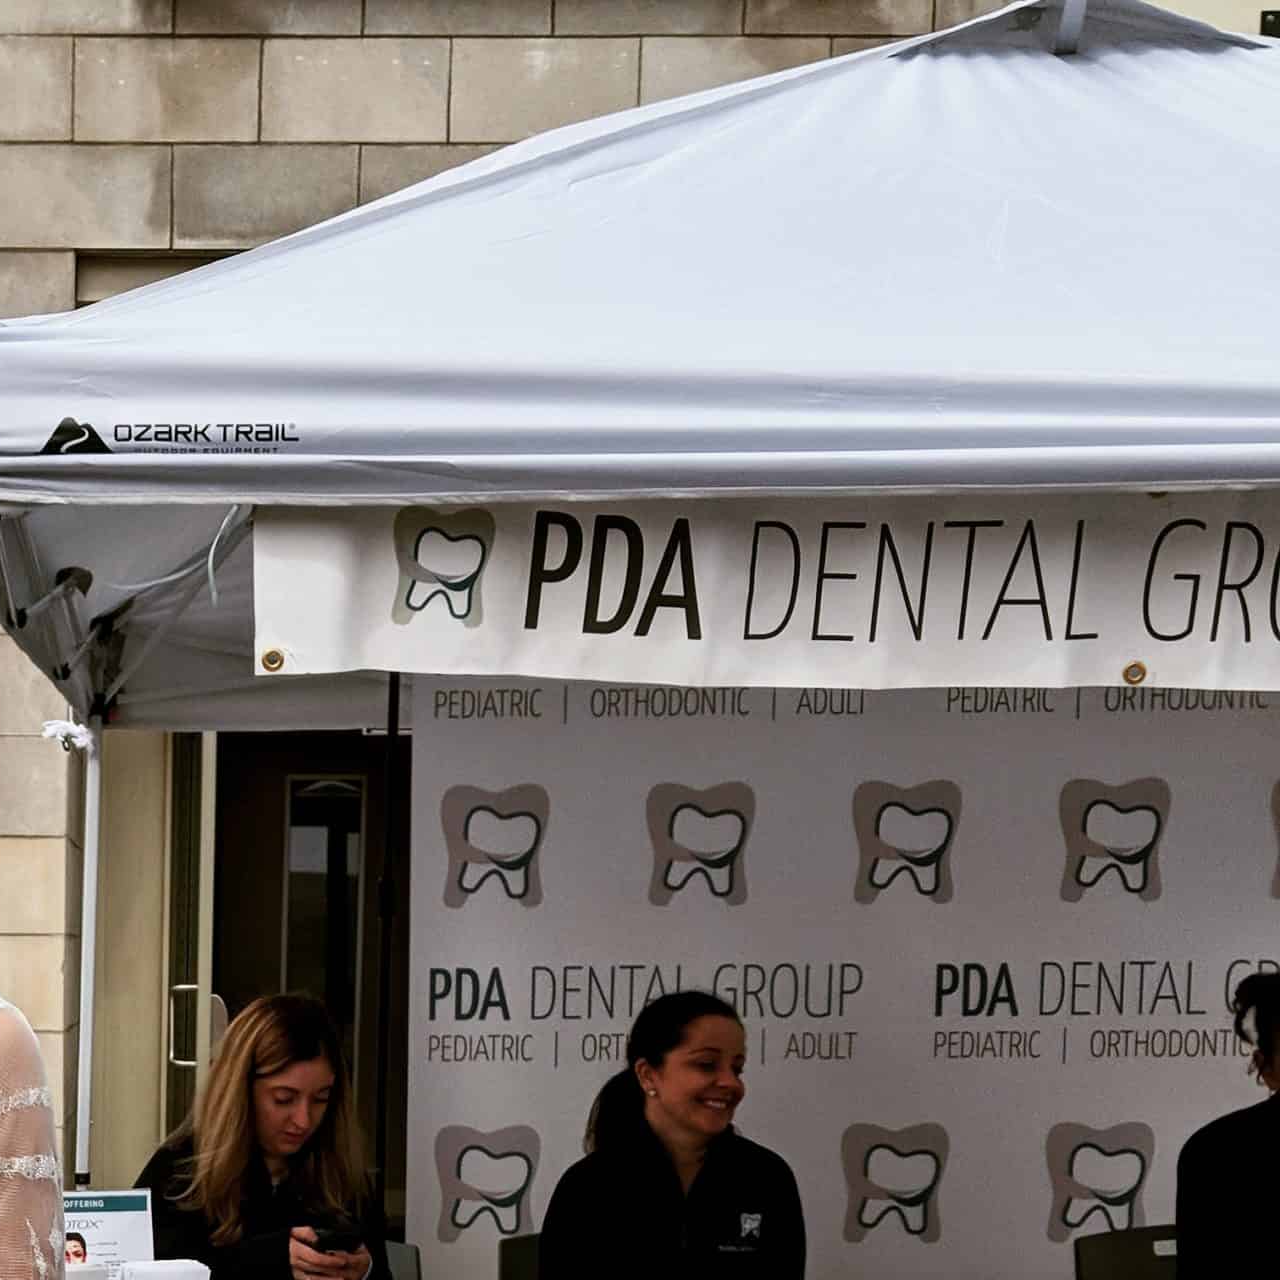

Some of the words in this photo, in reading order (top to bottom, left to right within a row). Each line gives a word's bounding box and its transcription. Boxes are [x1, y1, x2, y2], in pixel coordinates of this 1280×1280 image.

[524, 510, 702, 640] PDA
[743, 519, 1098, 642] DENTAL
[1143, 518, 1280, 642] GR
[433, 688, 543, 719] PEDIATRIC
[589, 687, 751, 719] ORTHODONTIC
[946, 687, 1054, 713] PEDIATRIC
[428, 966, 511, 1021] PDA
[713, 962, 863, 1018] GROUP
[934, 962, 1019, 1017] PDA
[1038, 960, 1207, 1016] DENTAL
[428, 1034, 533, 1062] PEDIATRIC
[784, 1031, 858, 1060] ADULT
[933, 1030, 1041, 1059] PEDIATRIC
[64, 1199, 104, 1208] OFFERING
